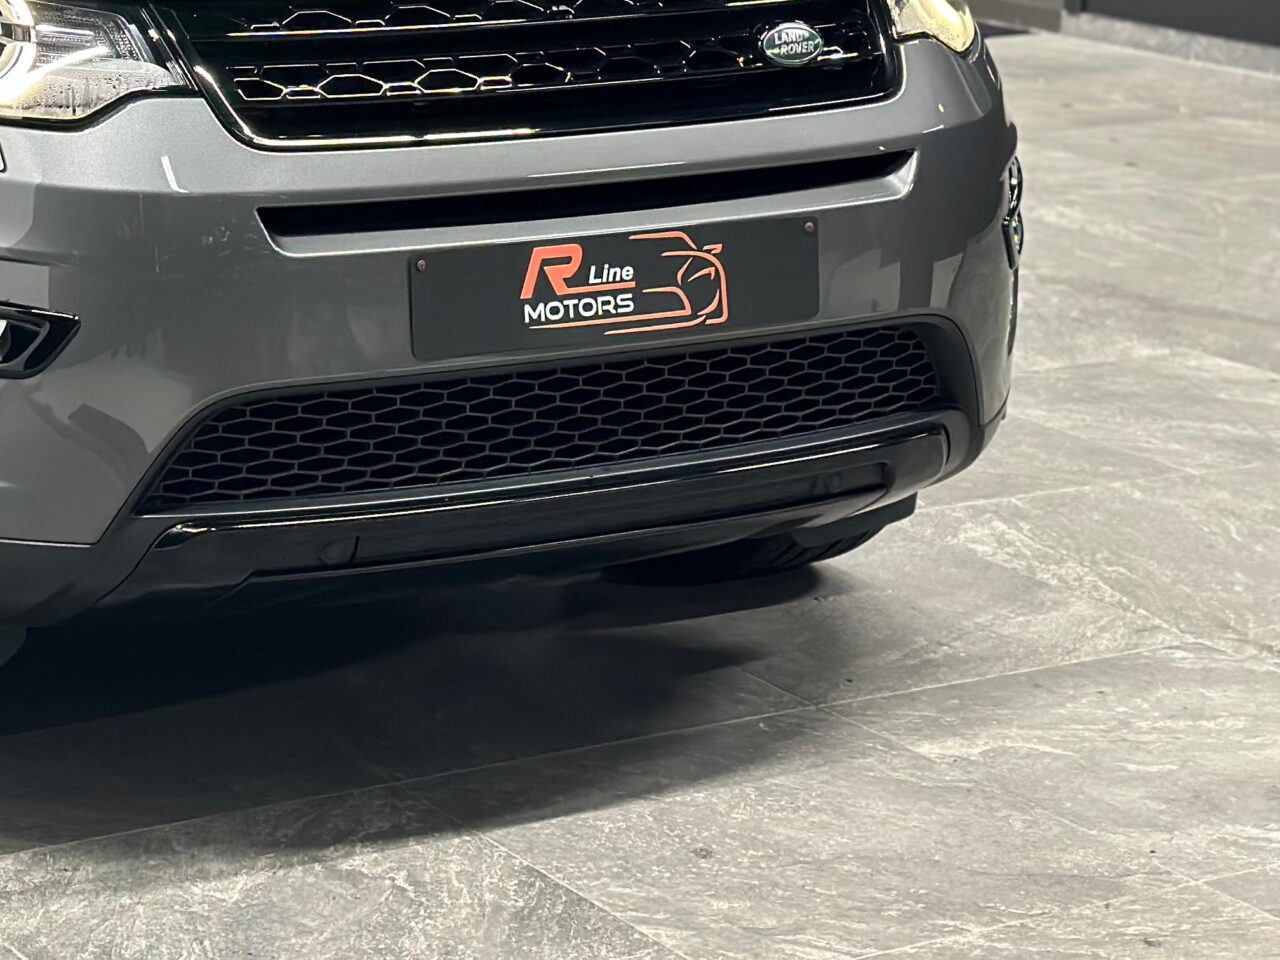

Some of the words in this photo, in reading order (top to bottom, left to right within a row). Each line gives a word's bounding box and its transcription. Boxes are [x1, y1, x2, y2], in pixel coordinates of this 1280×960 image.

[774, 29, 806, 45] LAND
[780, 40, 815, 56] ROVER
[520, 243, 583, 299] R
[588, 263, 634, 284] Line
[524, 293, 634, 323] MOTORS
